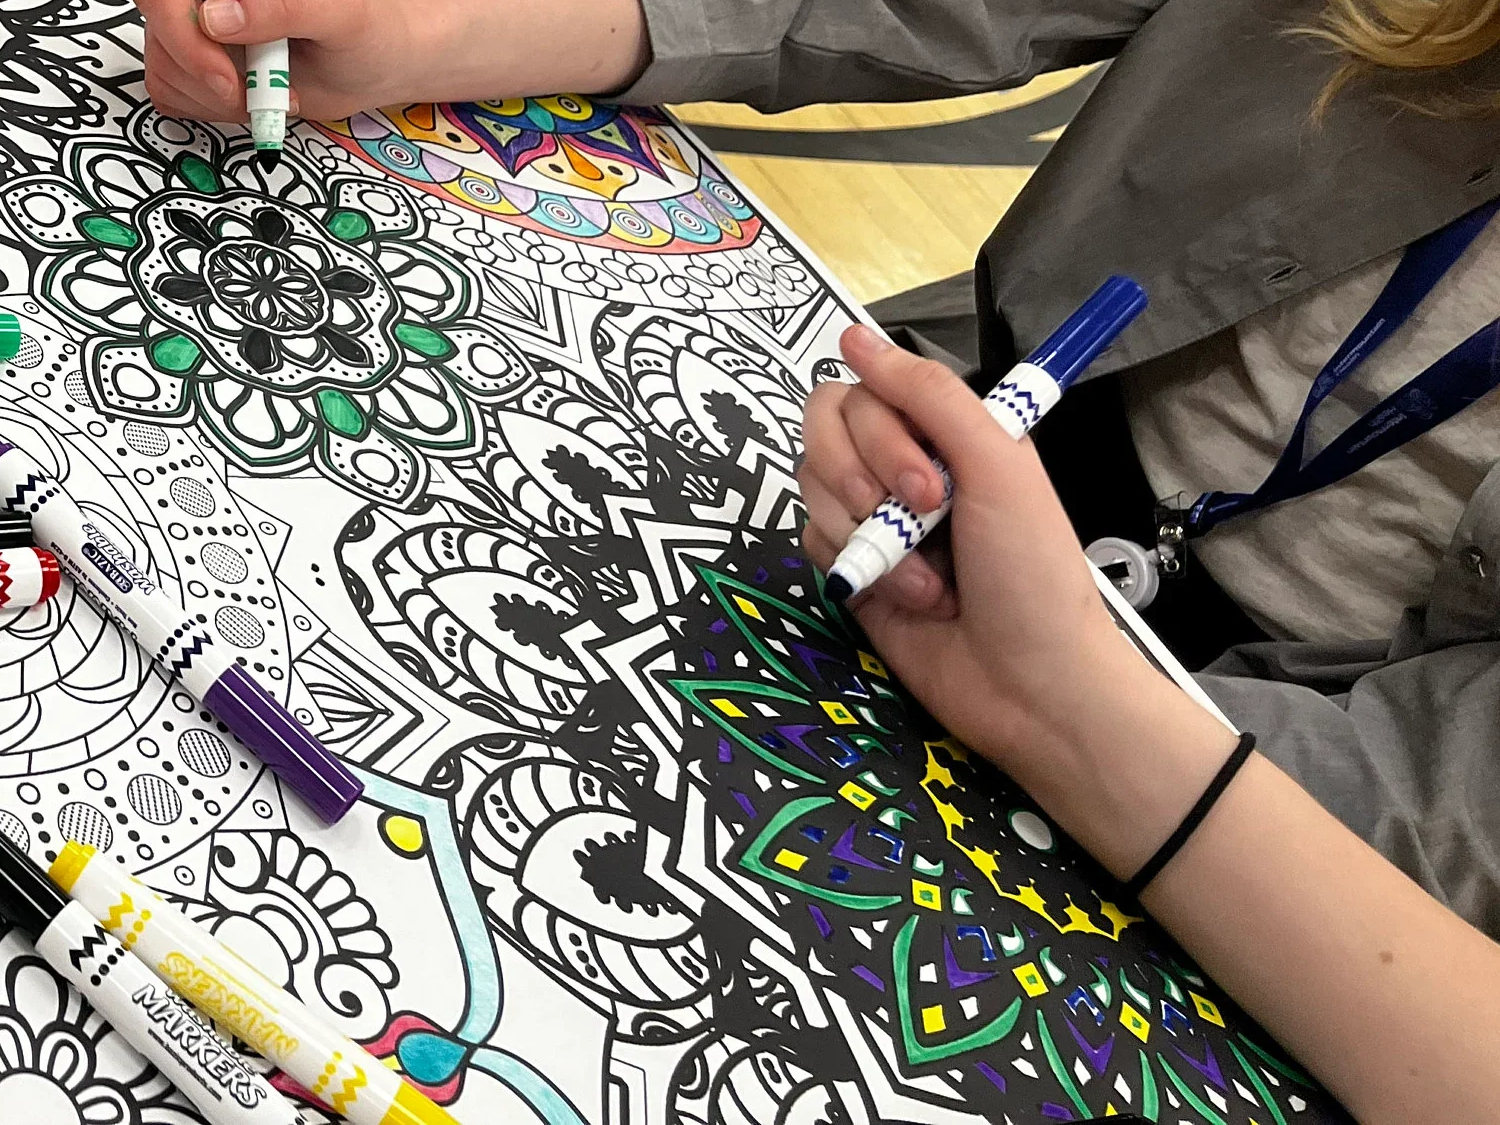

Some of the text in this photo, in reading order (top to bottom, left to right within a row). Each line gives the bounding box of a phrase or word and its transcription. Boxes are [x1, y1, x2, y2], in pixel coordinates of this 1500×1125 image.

[80, 520, 156, 596] Washable
[85, 547, 121, 584] BAZIC
[129, 978, 269, 1111] MARKERS
[155, 946, 300, 1063] MARKERS
